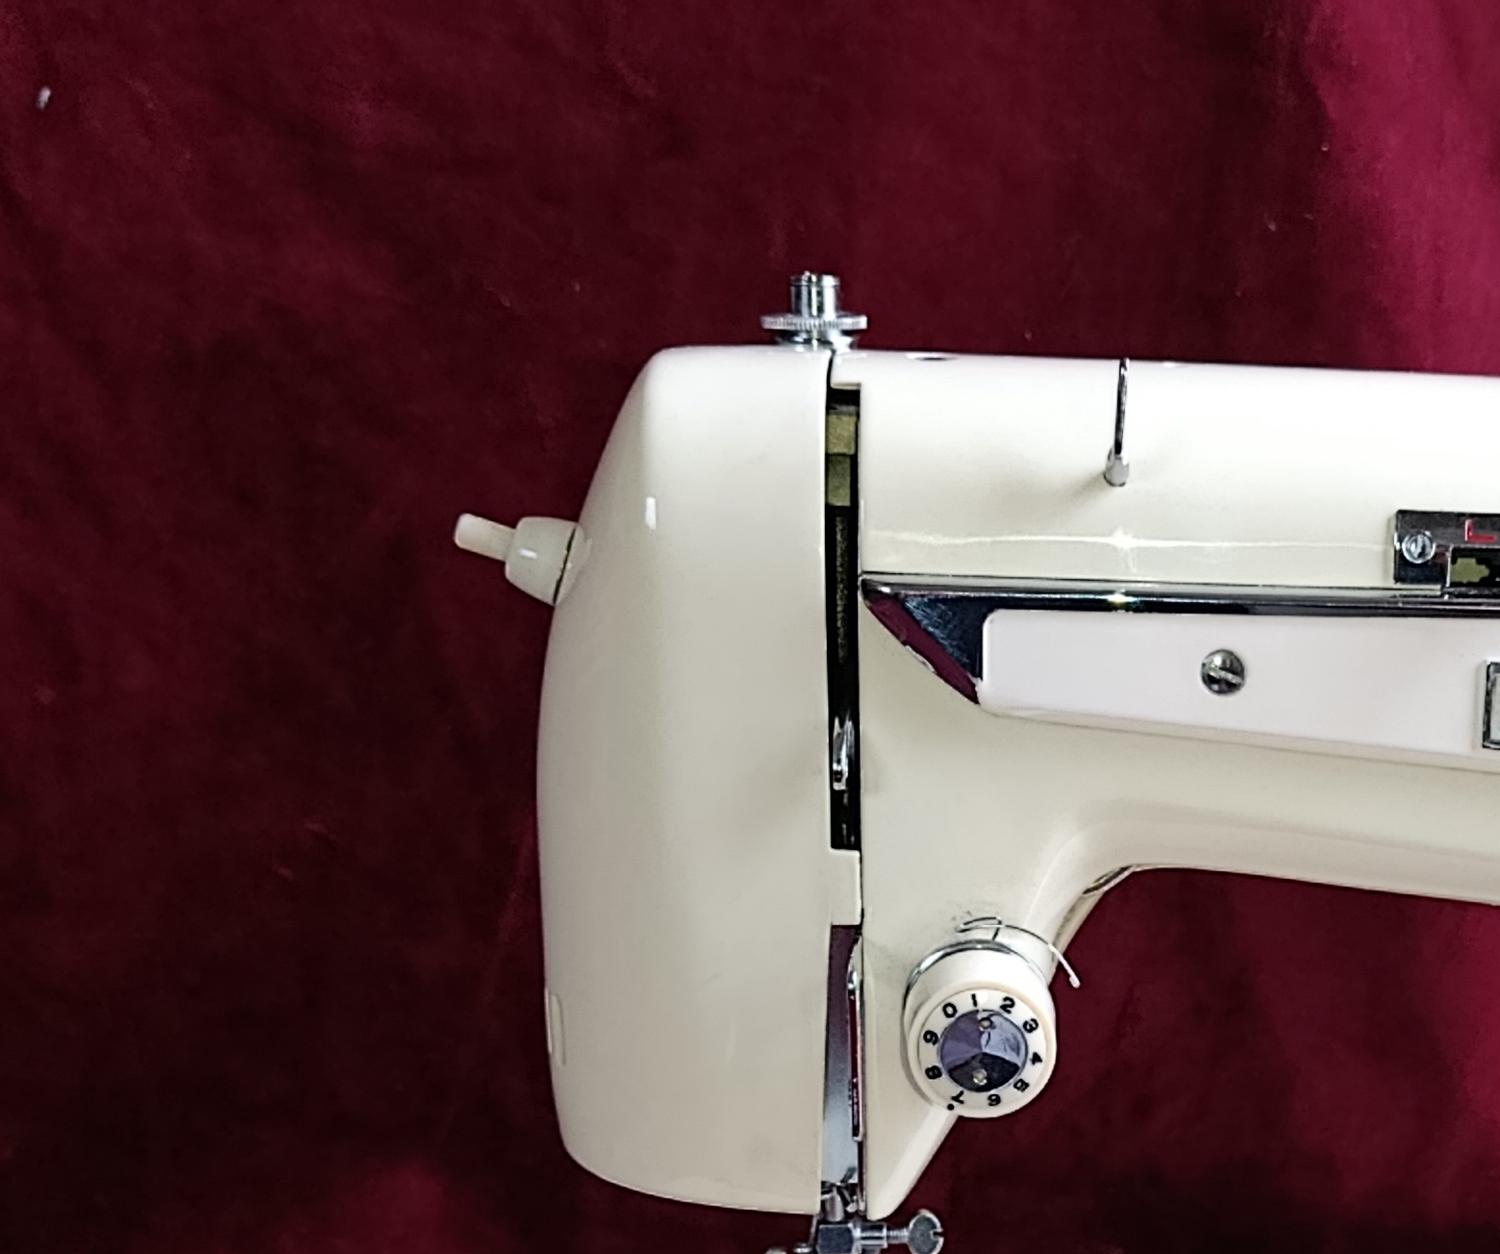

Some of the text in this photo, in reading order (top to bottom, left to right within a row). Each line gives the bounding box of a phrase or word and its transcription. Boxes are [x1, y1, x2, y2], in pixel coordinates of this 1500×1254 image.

[1464, 519, 1497, 543] L
[972, 994, 978, 1007] 1
[1001, 997, 1015, 1013] 2
[942, 1002, 958, 1019] 0
[1023, 1018, 1038, 1033] 3
[923, 1030, 939, 1046] 9
[1030, 1052, 1043, 1065] 4
[925, 1064, 943, 1080] 8
[987, 1093, 1002, 1107] 6
